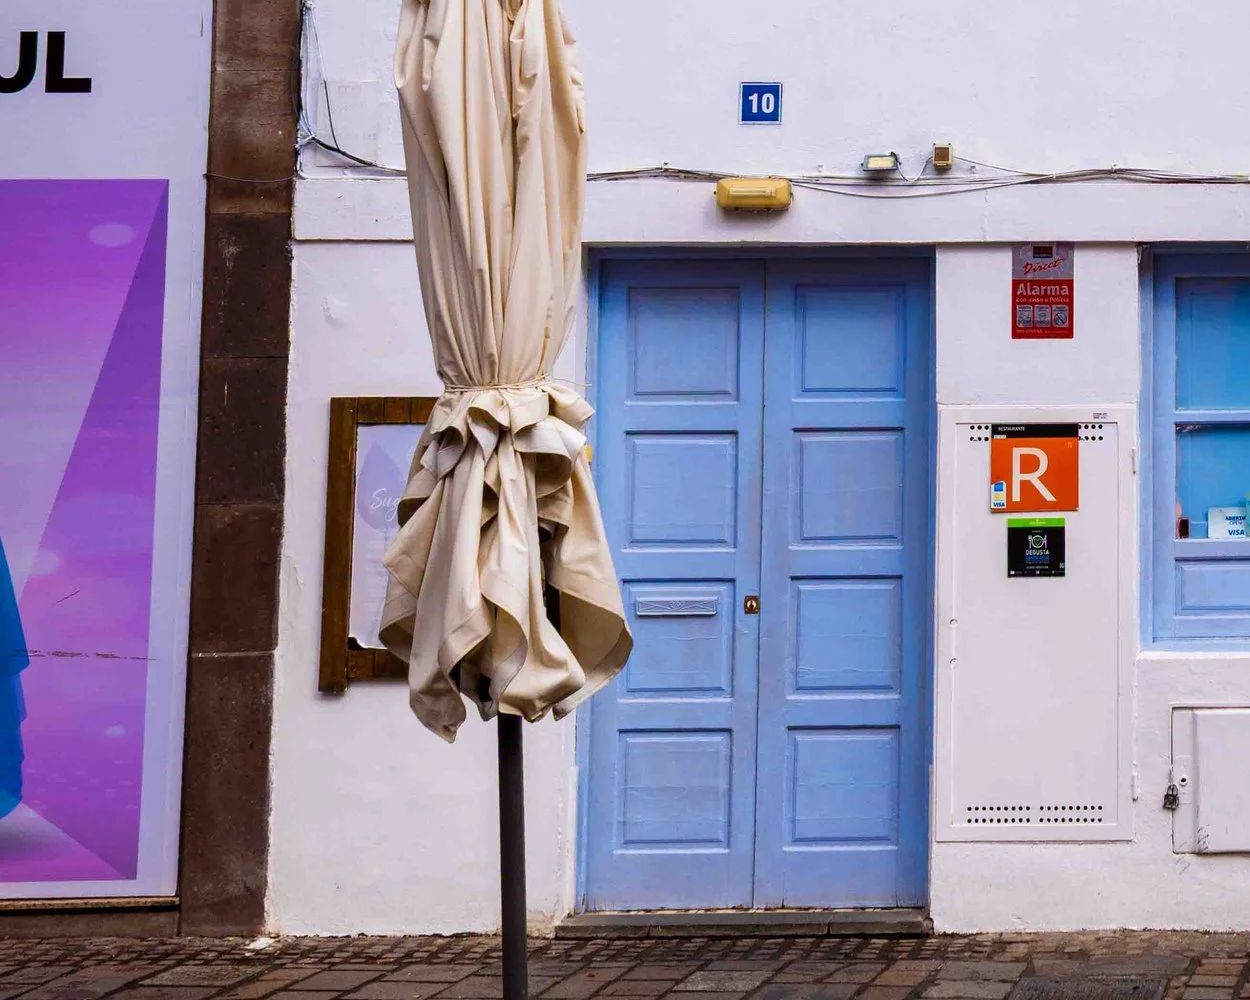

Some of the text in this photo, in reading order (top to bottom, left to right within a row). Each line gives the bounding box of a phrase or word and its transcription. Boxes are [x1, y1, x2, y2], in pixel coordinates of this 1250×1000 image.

[748, 92, 775, 114] 10
[1017, 282, 1069, 296] Alarma
[1012, 447, 1057, 502] R
